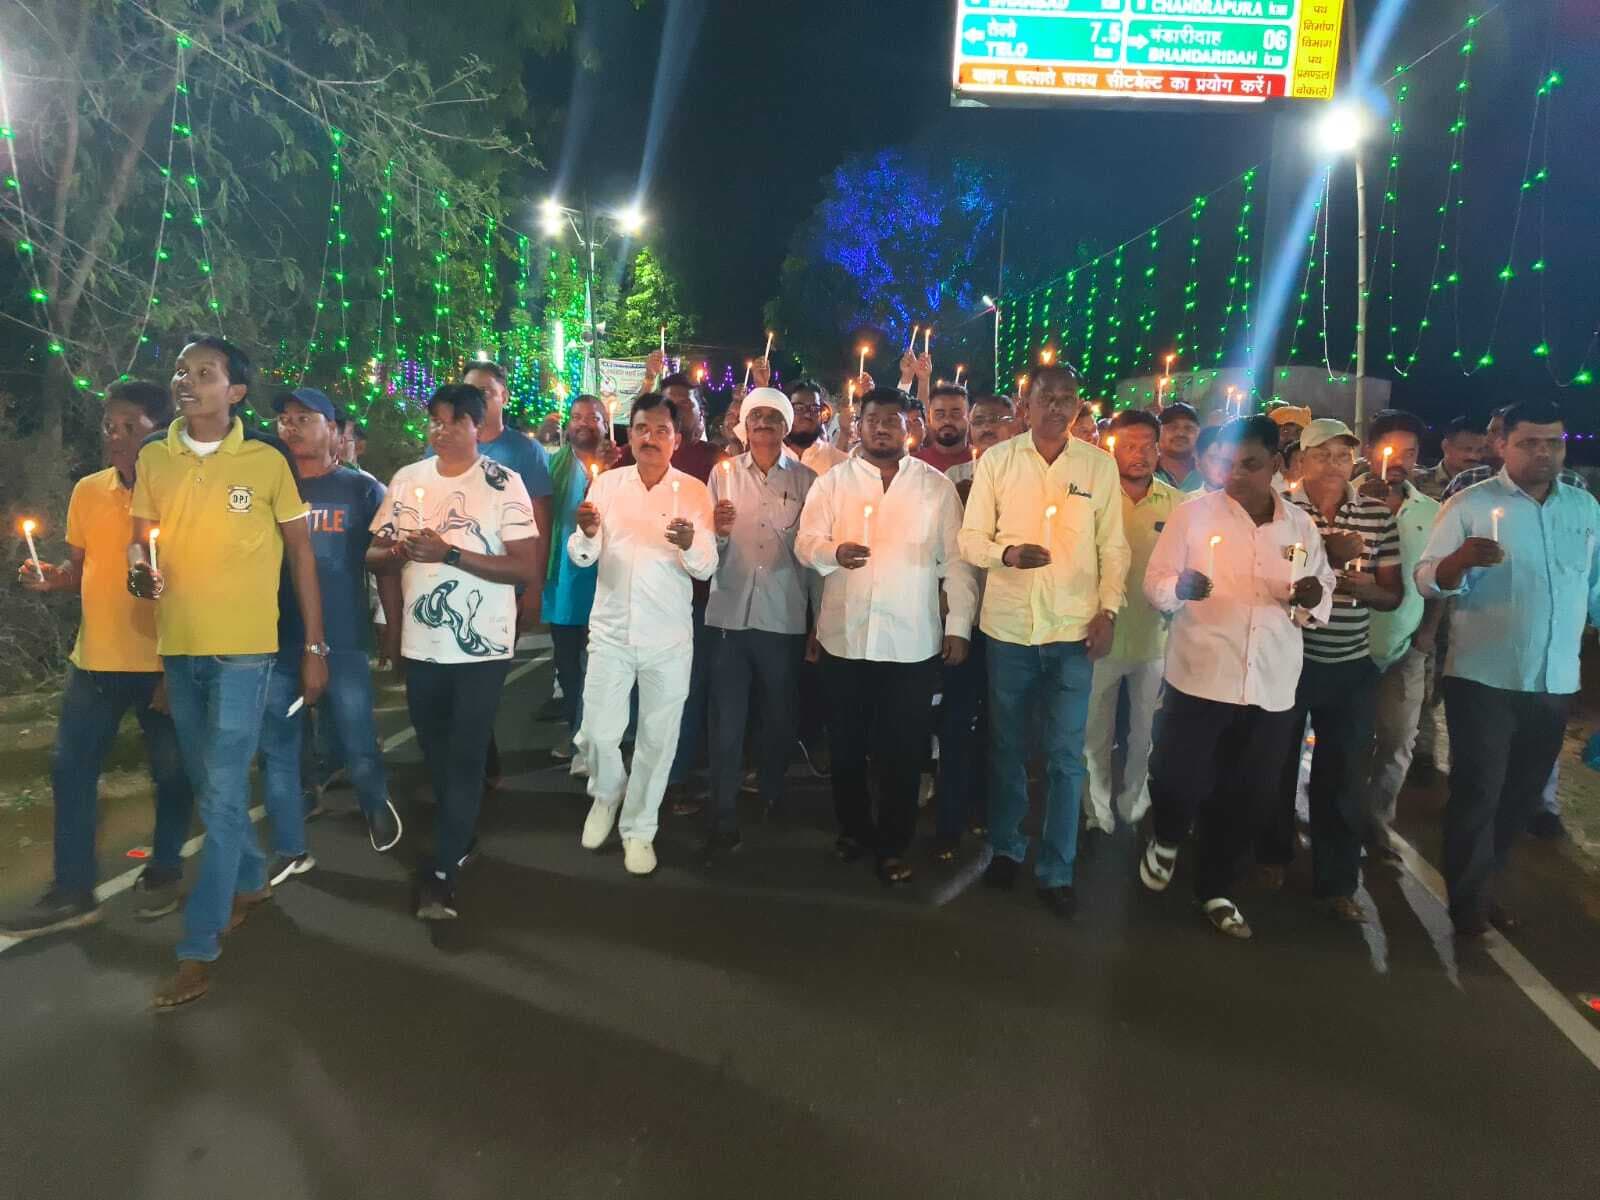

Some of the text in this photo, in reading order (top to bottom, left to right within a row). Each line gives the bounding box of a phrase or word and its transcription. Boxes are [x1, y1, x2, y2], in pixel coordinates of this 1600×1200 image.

[1090, 21, 1121, 43] 7.5
[1263, 29, 1288, 50] 06
[1148, 47, 1258, 65] BHANDARIDAH
[1170, 76, 1190, 91] का
[1195, 73, 1233, 92] प्रयोग
